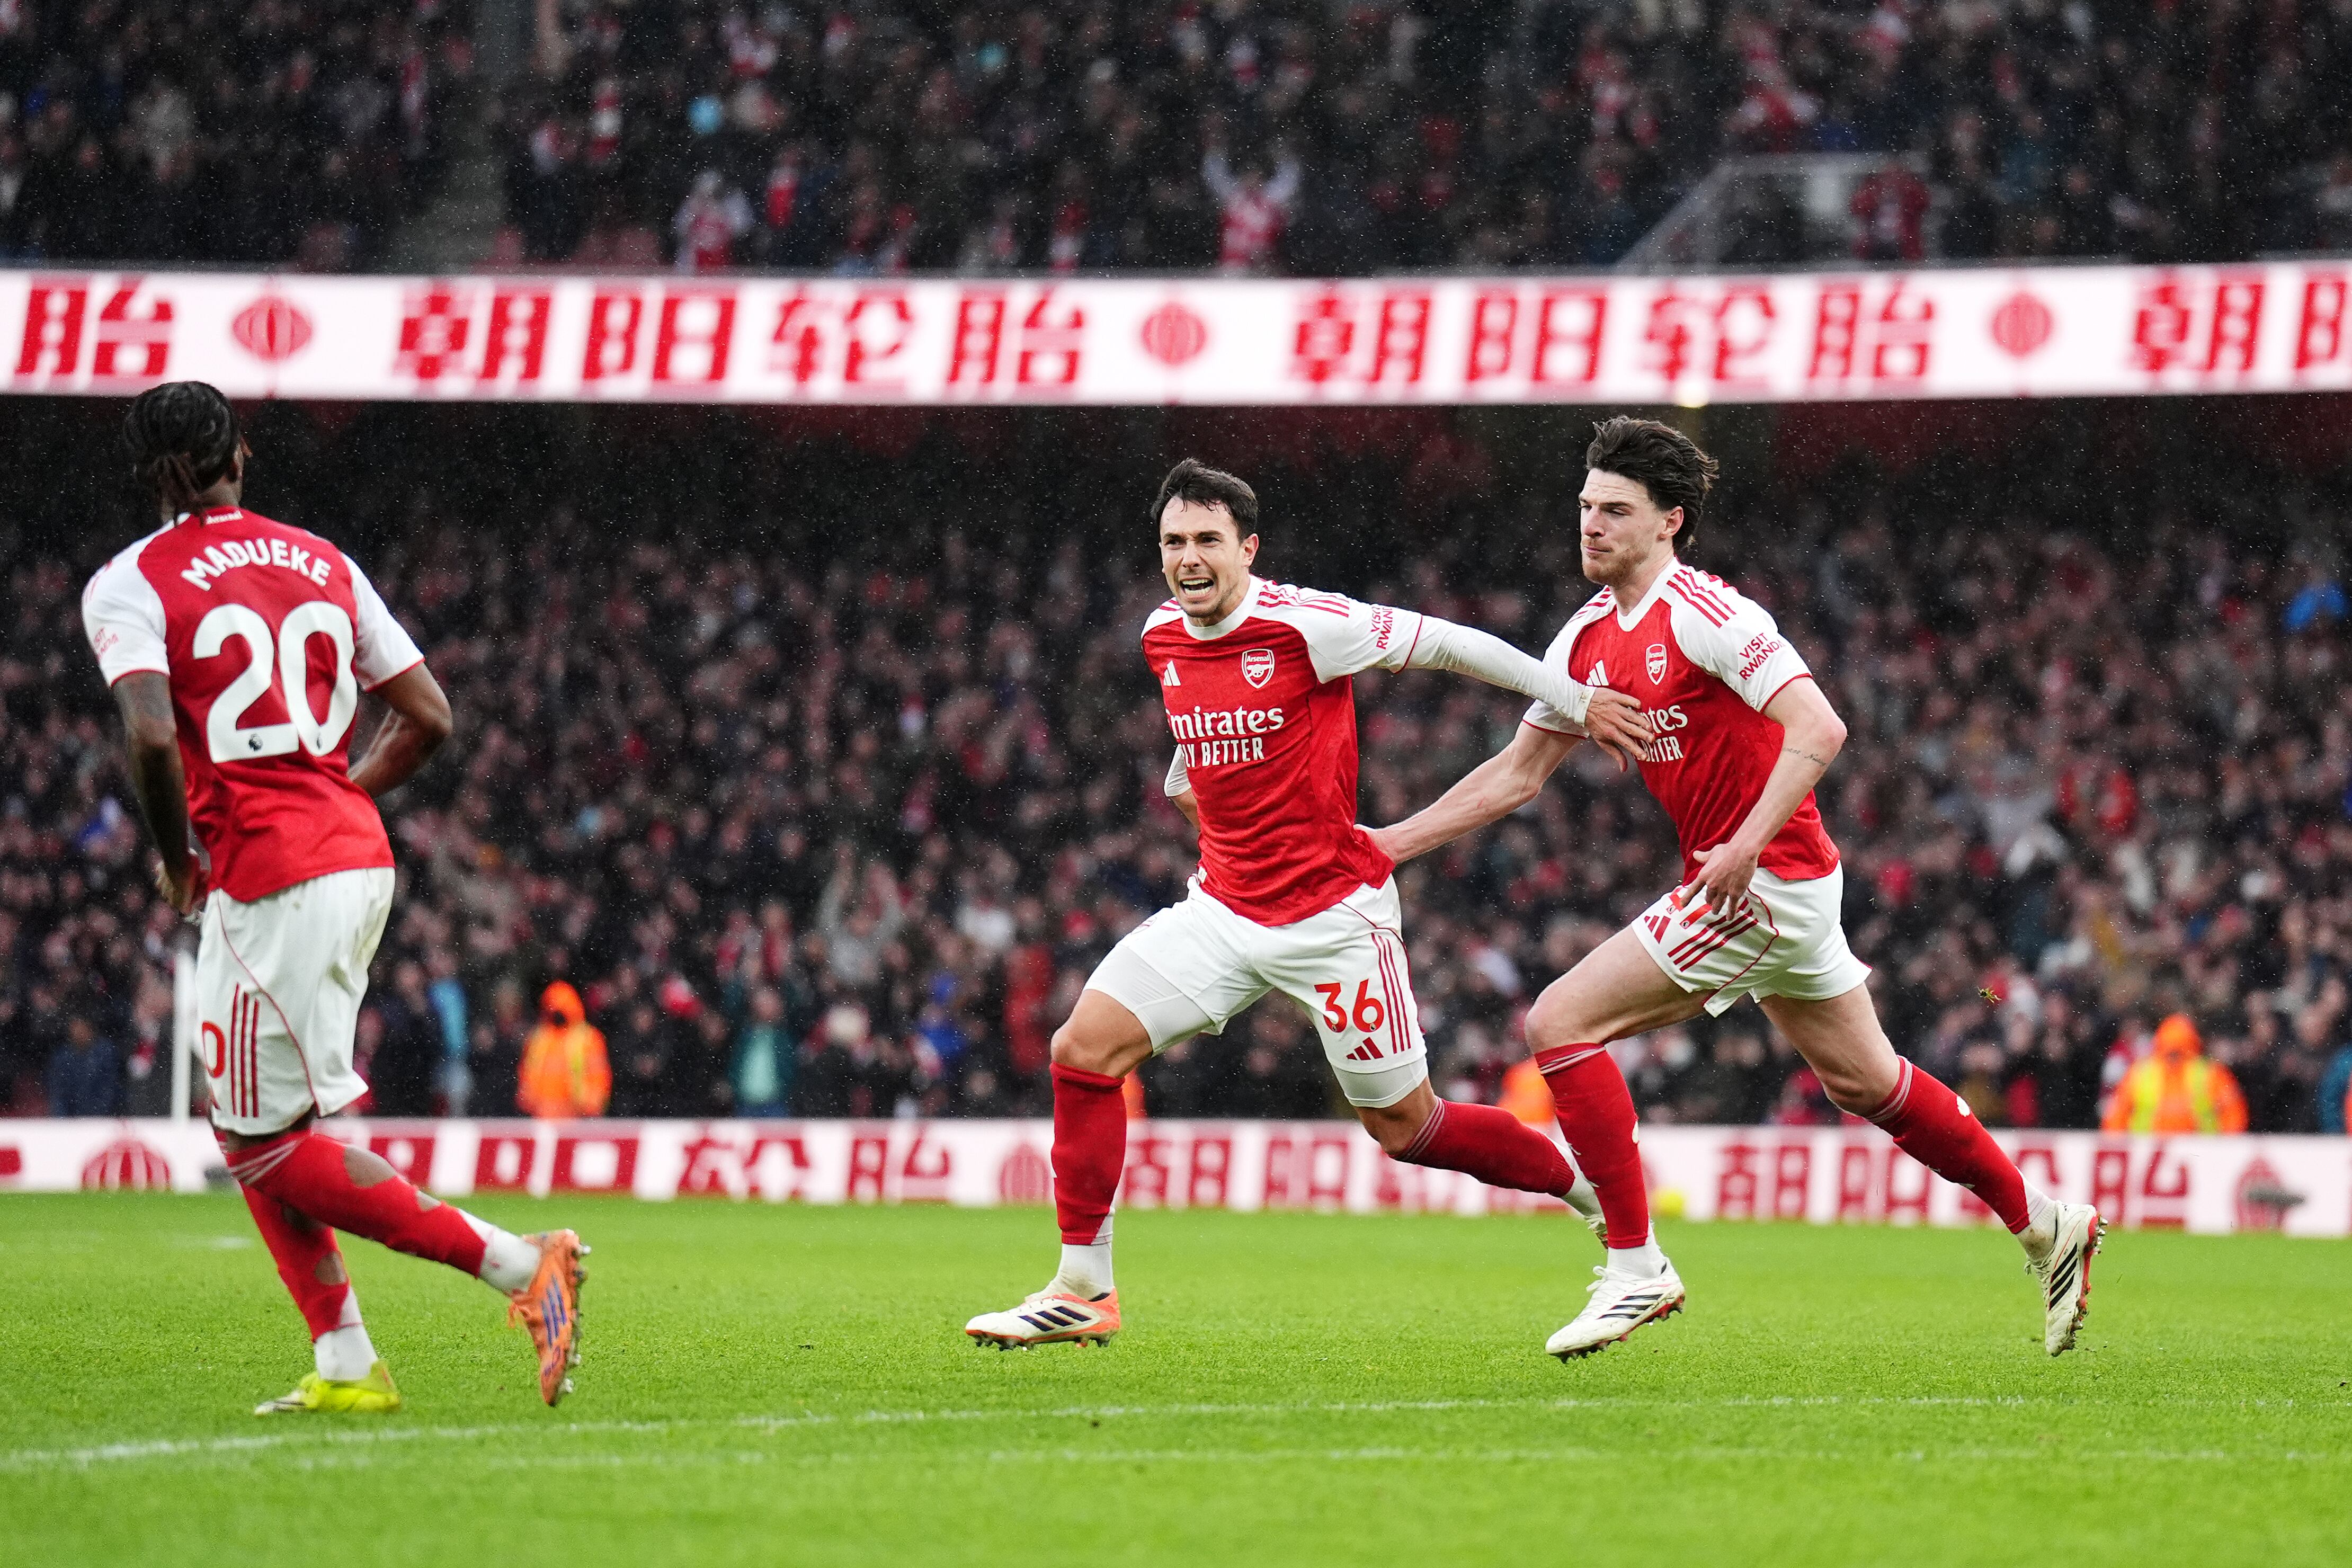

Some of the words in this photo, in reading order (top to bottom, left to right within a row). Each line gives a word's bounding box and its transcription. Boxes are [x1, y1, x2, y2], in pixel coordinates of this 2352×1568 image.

[181, 537, 332, 592] MADUEKE
[1739, 632, 1768, 658] VISIT
[1739, 639, 1786, 681] RWANDA
[192, 600, 358, 764] 20
[1201, 737, 1265, 767] BETTER
[1314, 978, 1385, 1033] 36
